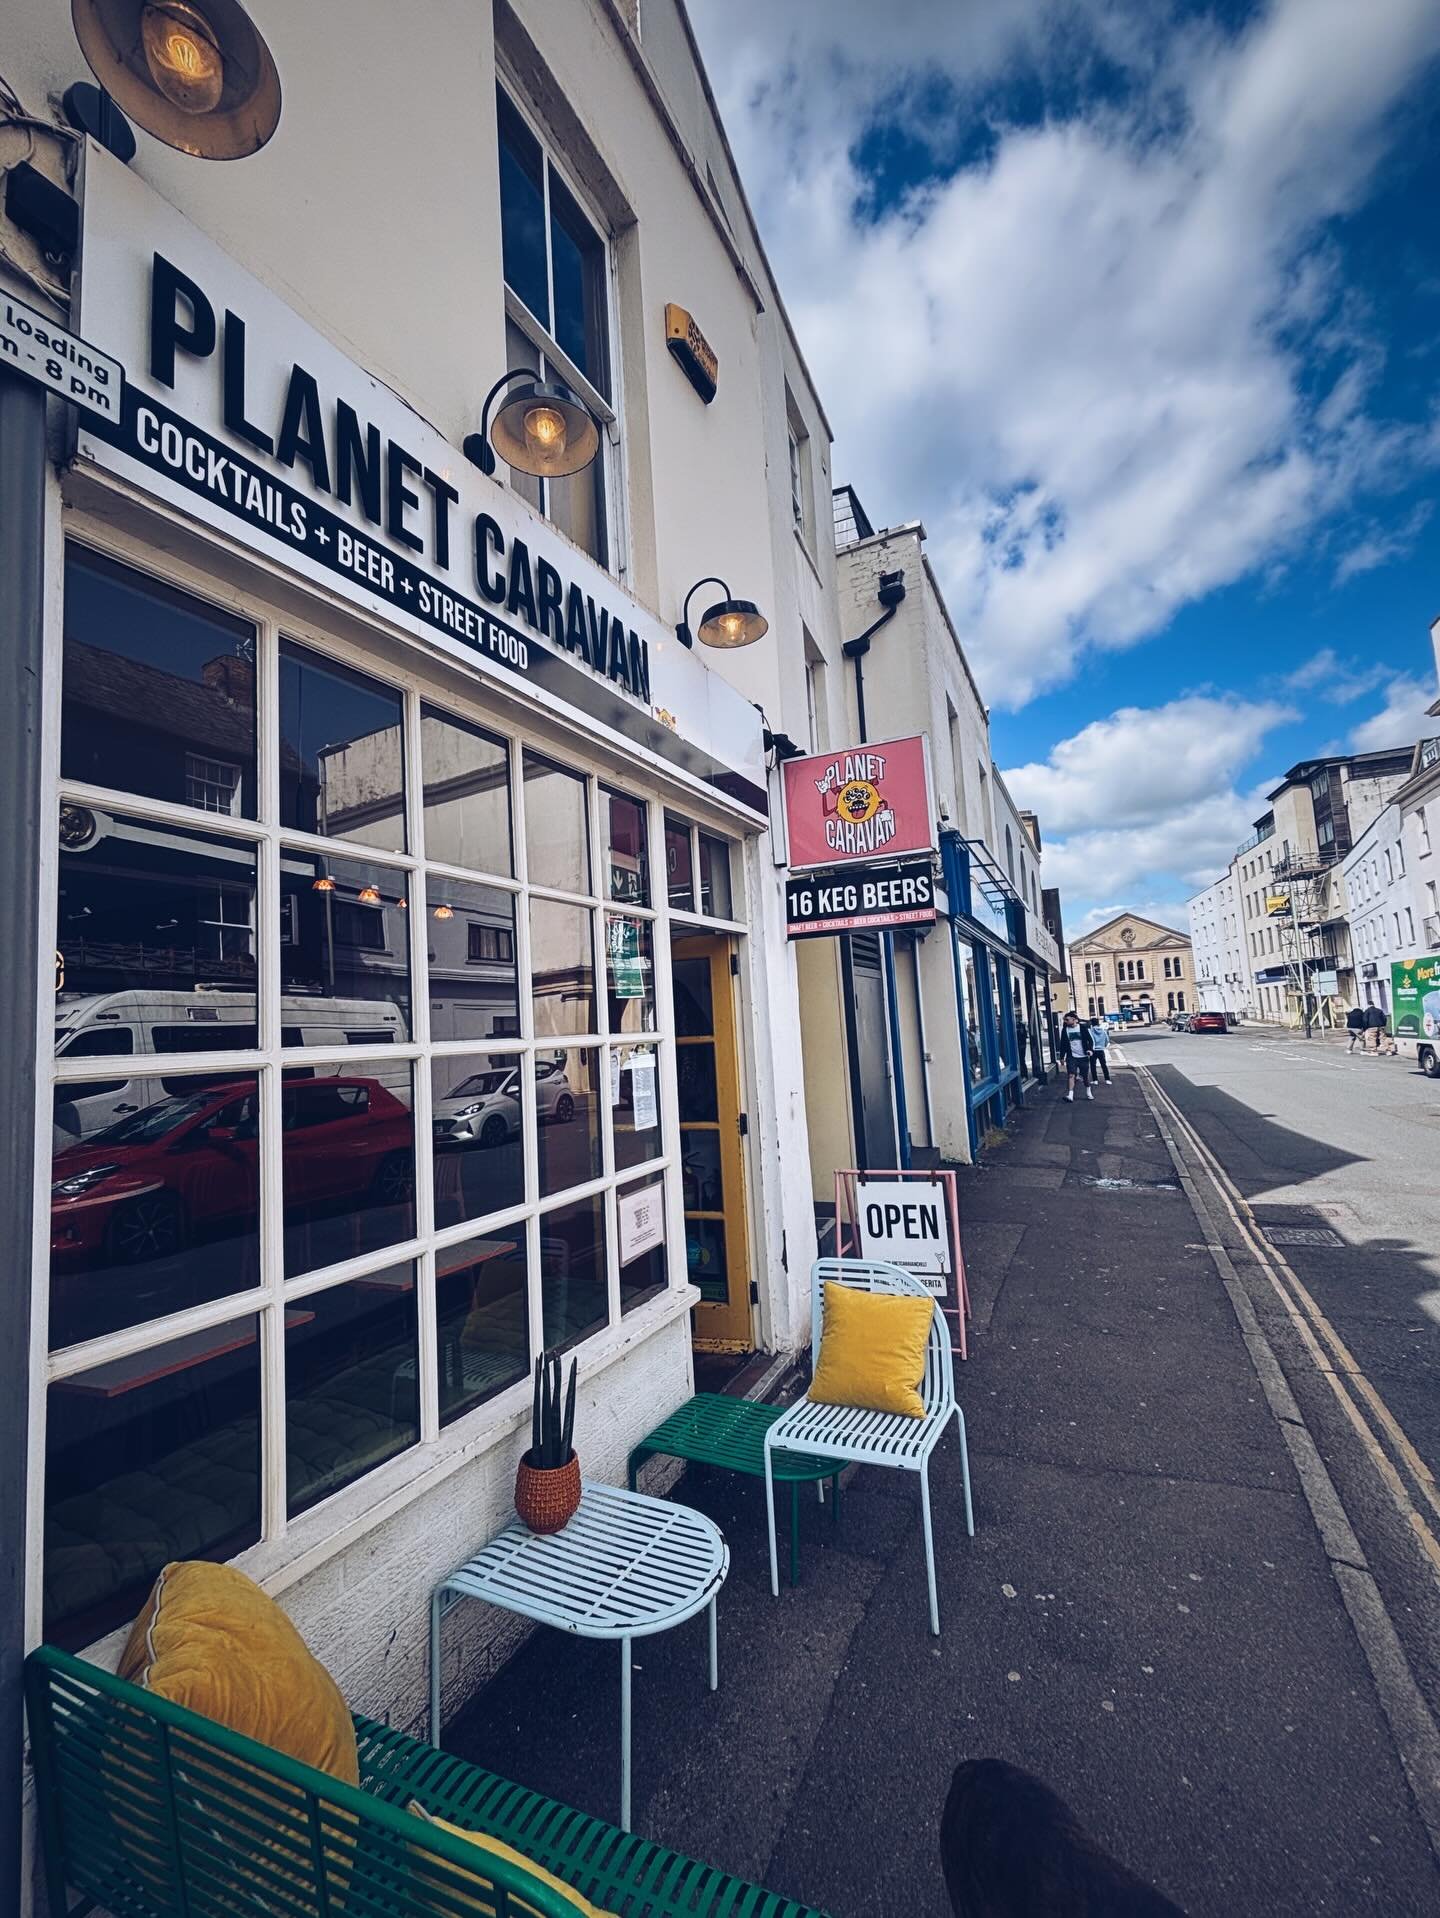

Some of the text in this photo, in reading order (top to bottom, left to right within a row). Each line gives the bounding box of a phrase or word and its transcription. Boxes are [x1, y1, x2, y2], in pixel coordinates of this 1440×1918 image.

[6, 305, 109, 385] loading
[45, 358, 63, 381] 8
[70, 375, 110, 410] pm
[150, 251, 650, 705] PLANET CARAVAN
[137, 407, 529, 670] COCKTAILS + BEER + STREET FOOD
[826, 754, 887, 786] PLANET
[825, 808, 896, 854] CARAVAN
[788, 876, 931, 917] 16 KEG BEERS
[822, 919, 849, 929] COCKTAILS
[867, 914, 895, 925] COCKTAILS
[900, 911, 919, 921] STREET
[919, 910, 933, 919] FOOD
[866, 1203, 940, 1240] OPEN
